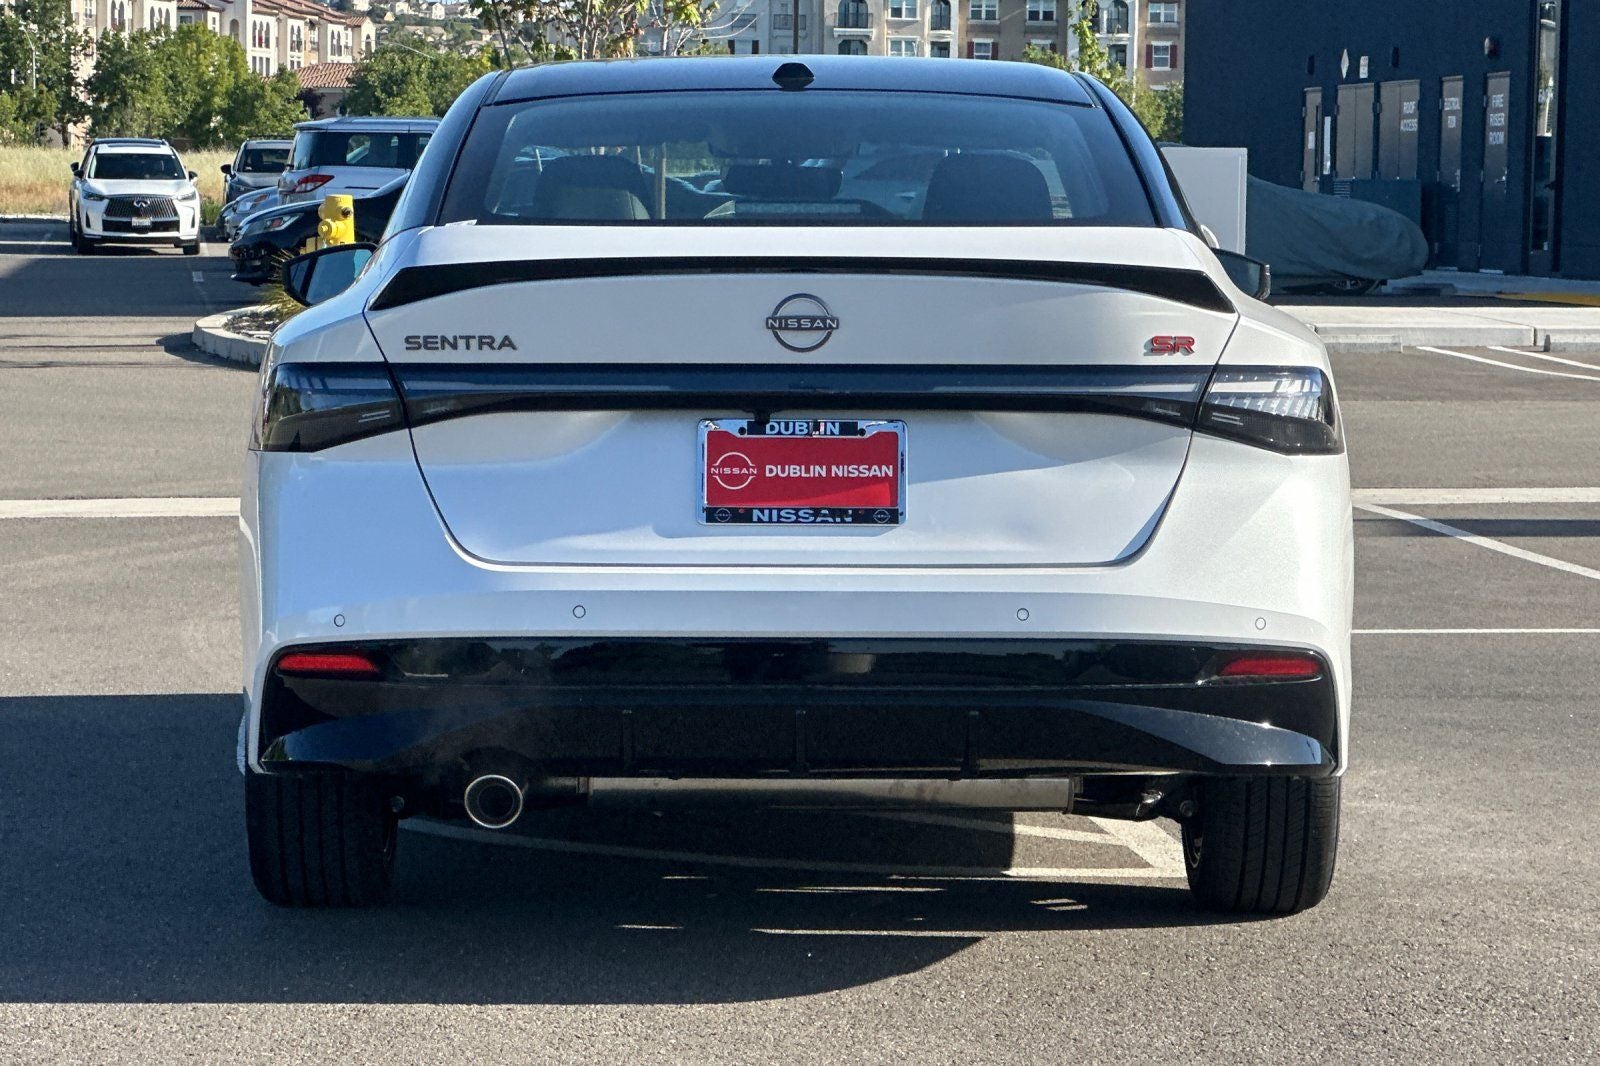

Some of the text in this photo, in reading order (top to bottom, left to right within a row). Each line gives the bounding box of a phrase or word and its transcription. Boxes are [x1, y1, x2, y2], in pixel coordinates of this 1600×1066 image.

[1403, 101, 1416, 114] ROOF
[1492, 93, 1504, 108] FIRE
[1400, 118, 1418, 132] ACCESS
[1489, 112, 1505, 127] RISER
[1489, 131, 1505, 145] ROOM
[767, 318, 838, 329] NISSAN
[404, 334, 518, 351] SENTRA
[1150, 335, 1195, 354] SR
[765, 421, 840, 436] DUBLIN
[710, 467, 758, 475] NISSAN
[765, 464, 894, 478] DUBLIN NISSAN
